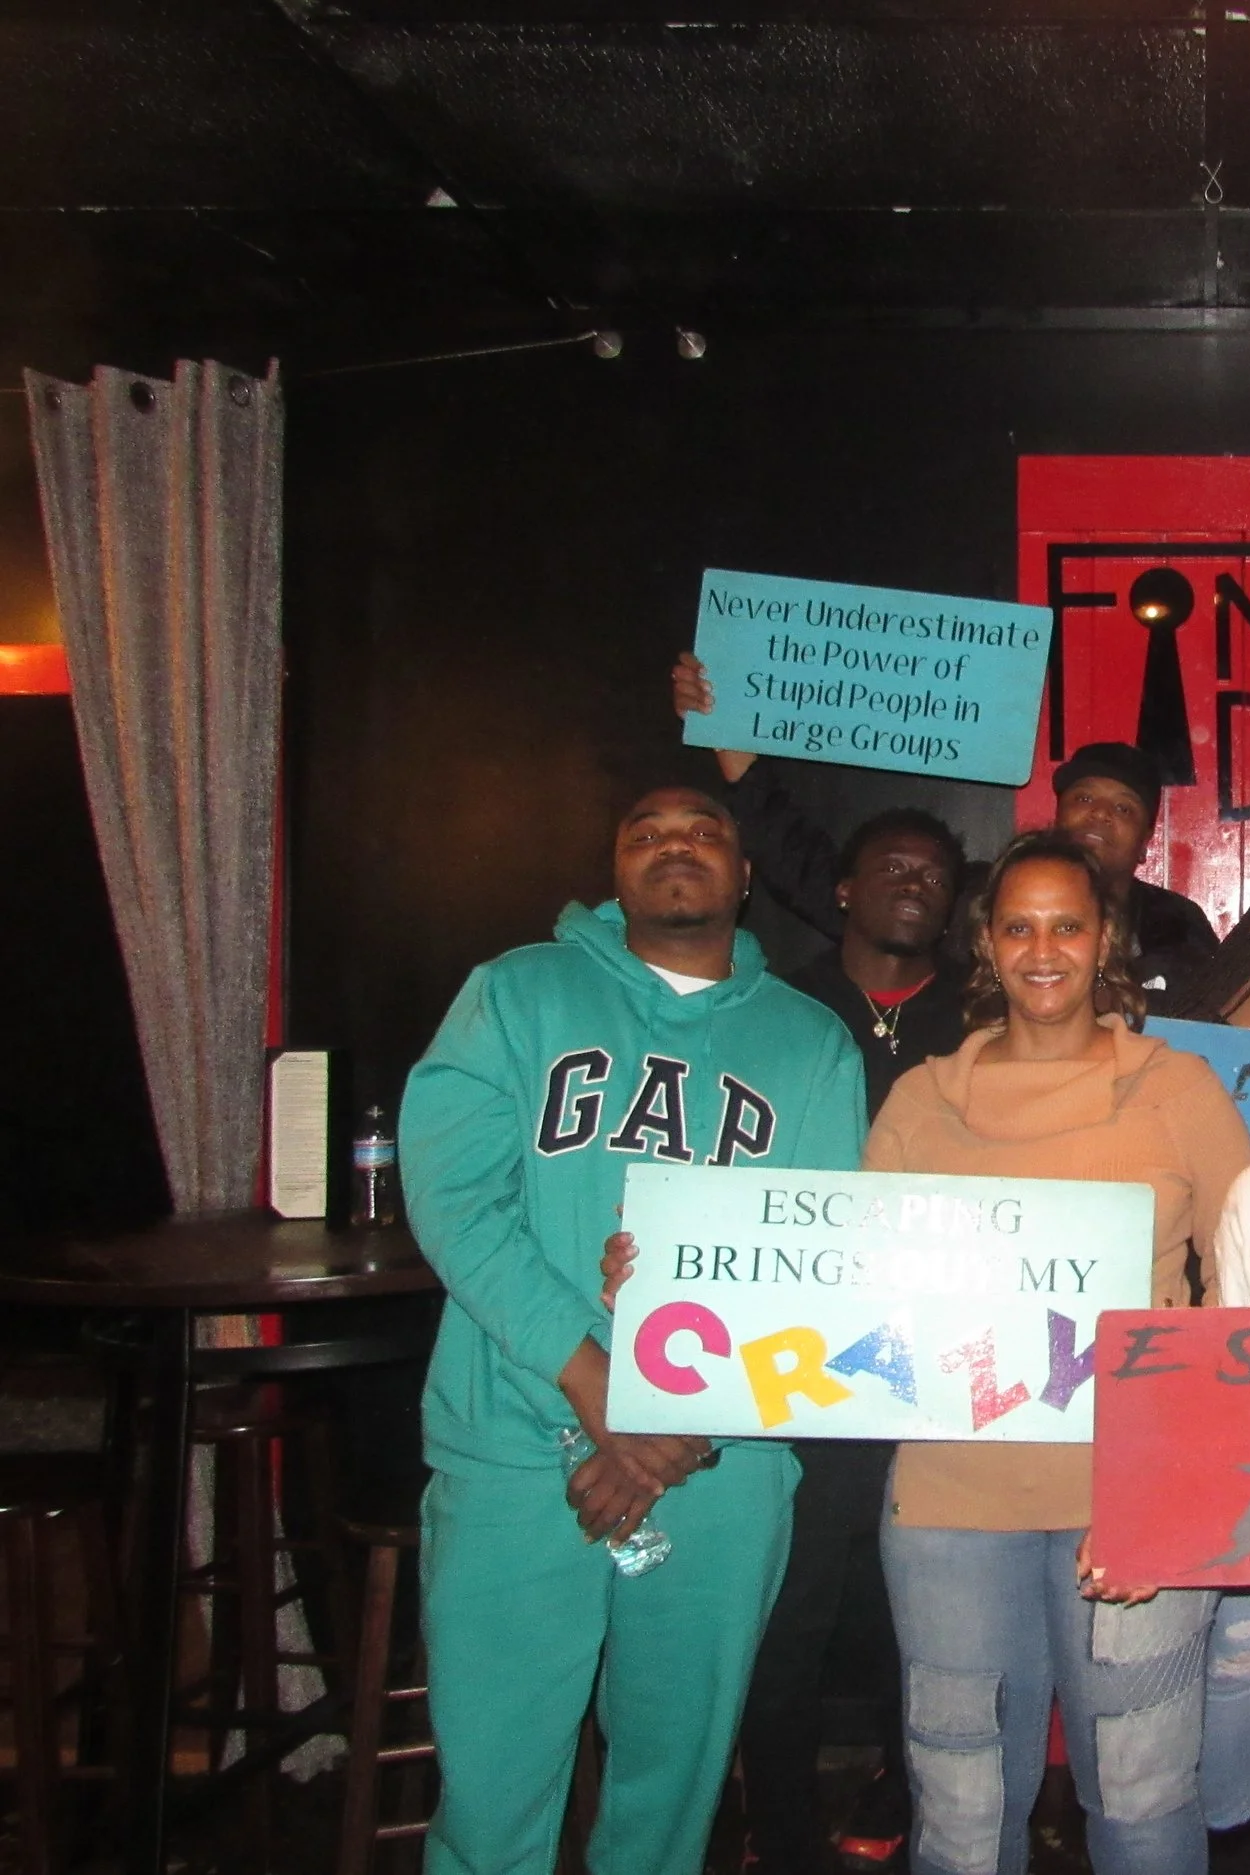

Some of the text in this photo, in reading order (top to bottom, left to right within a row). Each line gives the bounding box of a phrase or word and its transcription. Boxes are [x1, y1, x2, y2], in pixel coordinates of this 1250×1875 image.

[706, 588, 1040, 651] Never Underestimate
[767, 634, 971, 682] the Power of
[743, 671, 981, 724] Stupid People in
[751, 711, 963, 765] Large Groups
[535, 1047, 777, 1166] GAP
[673, 1243, 873, 1287] BRINGS
[1018, 1257, 1099, 1294] MY
[634, 1301, 1096, 1432] CRAZY
